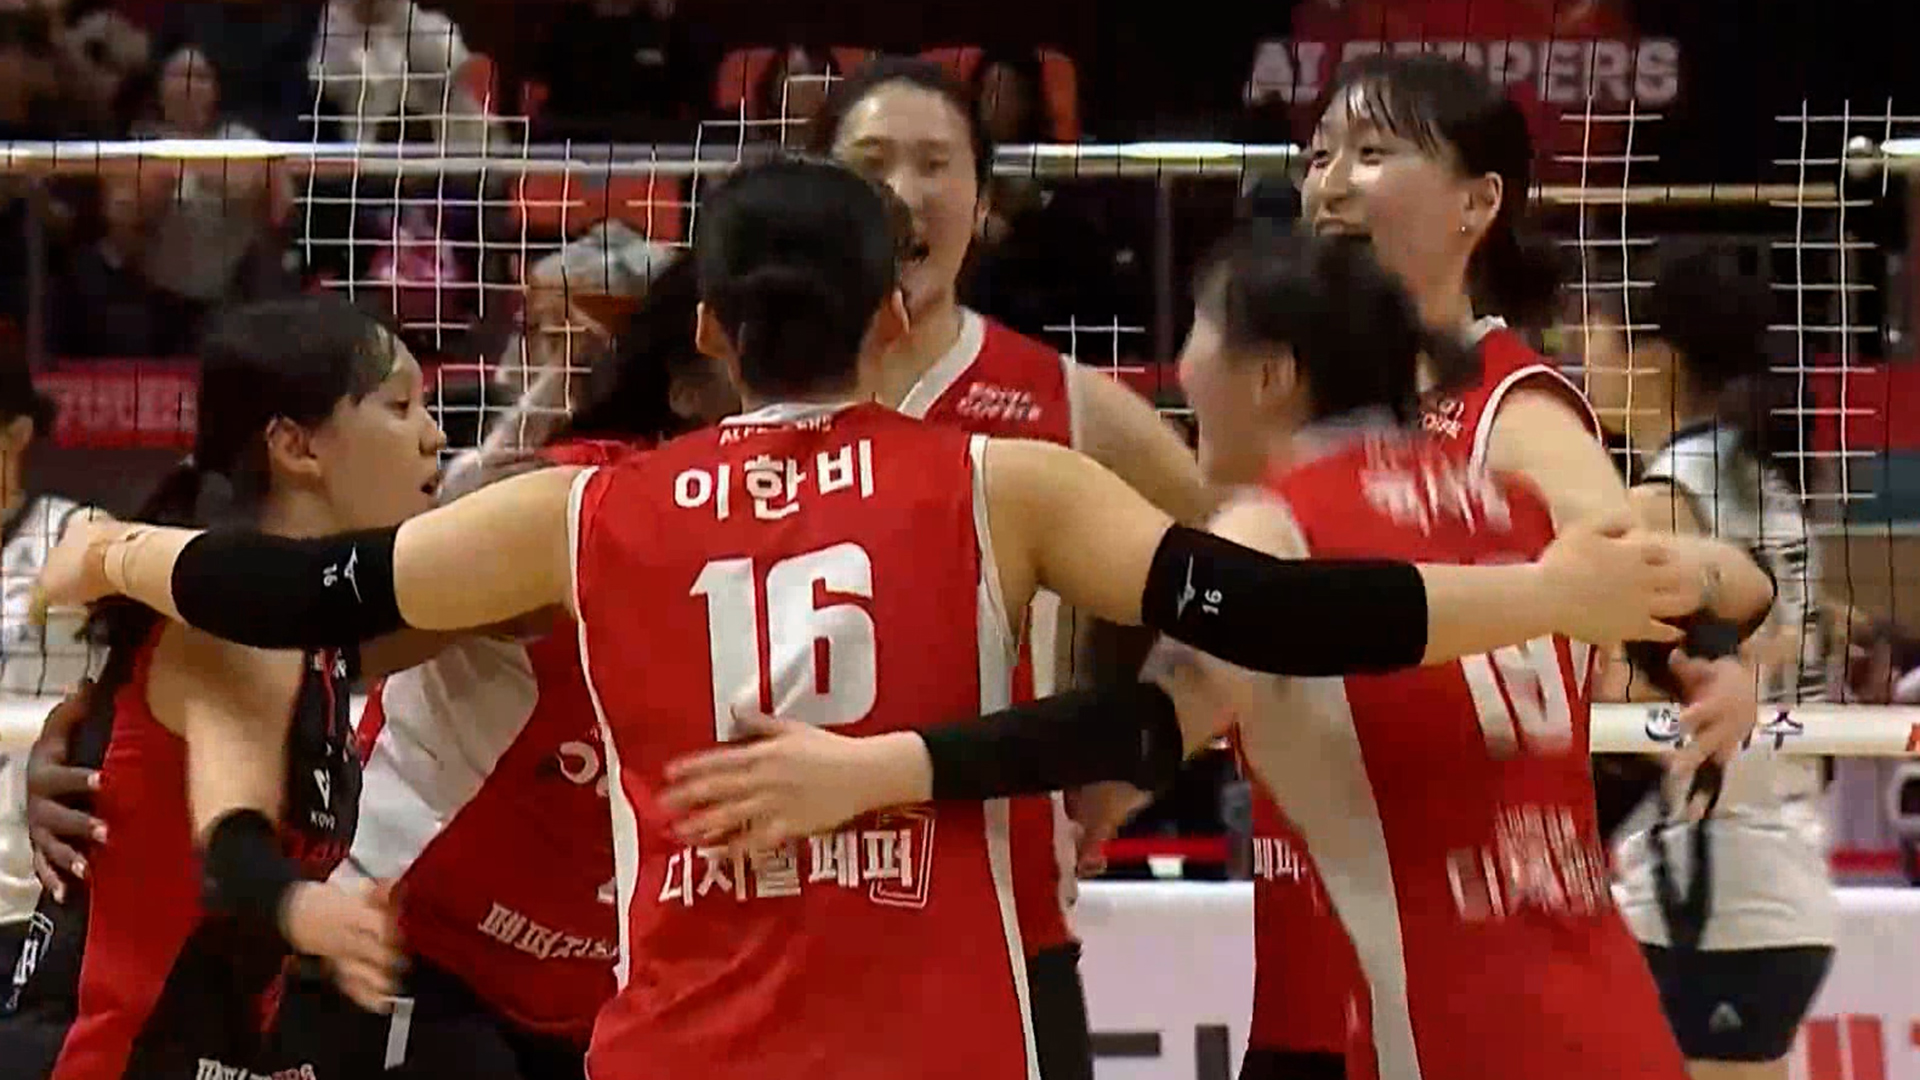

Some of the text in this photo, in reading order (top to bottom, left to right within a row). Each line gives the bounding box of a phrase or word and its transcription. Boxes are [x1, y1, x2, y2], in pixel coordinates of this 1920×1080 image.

[1340, 41, 1679, 101] PERS
[674, 439, 874, 521] 이한비
[323, 562, 338, 588] 16
[1202, 589, 1222, 616] 16
[689, 541, 878, 742] 16
